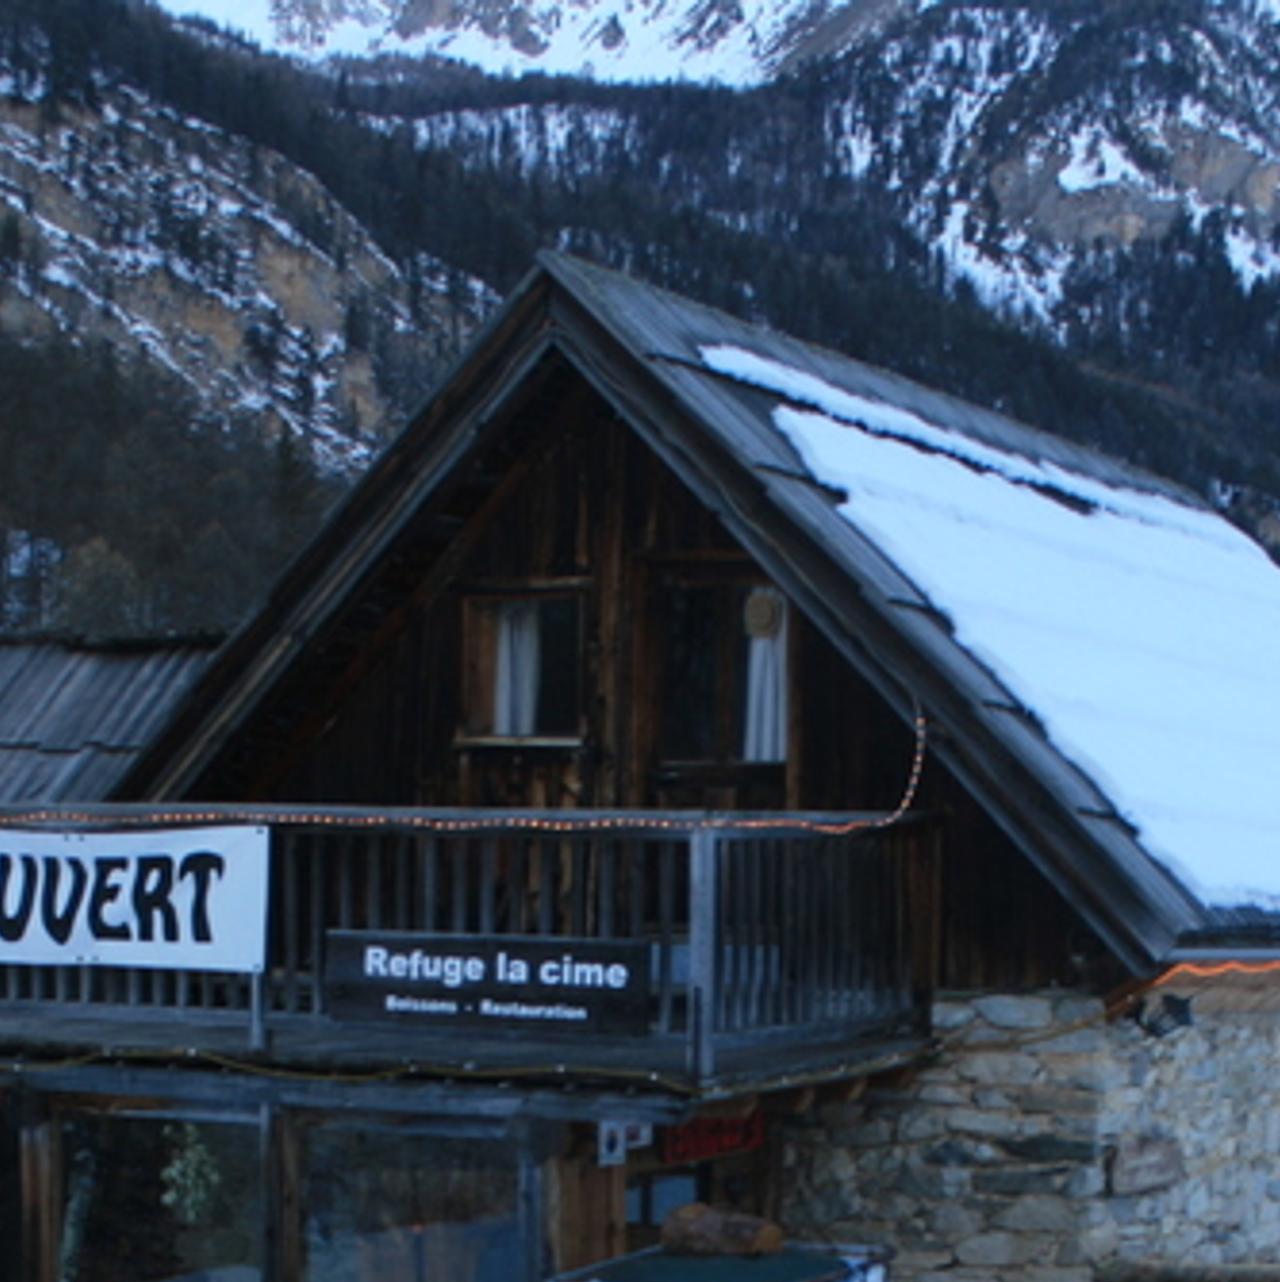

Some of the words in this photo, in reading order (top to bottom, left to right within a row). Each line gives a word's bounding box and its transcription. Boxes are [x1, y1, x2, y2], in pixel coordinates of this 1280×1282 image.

[364, 946, 485, 987] Refuge
[496, 952, 528, 983] la
[539, 955, 630, 988] cime
